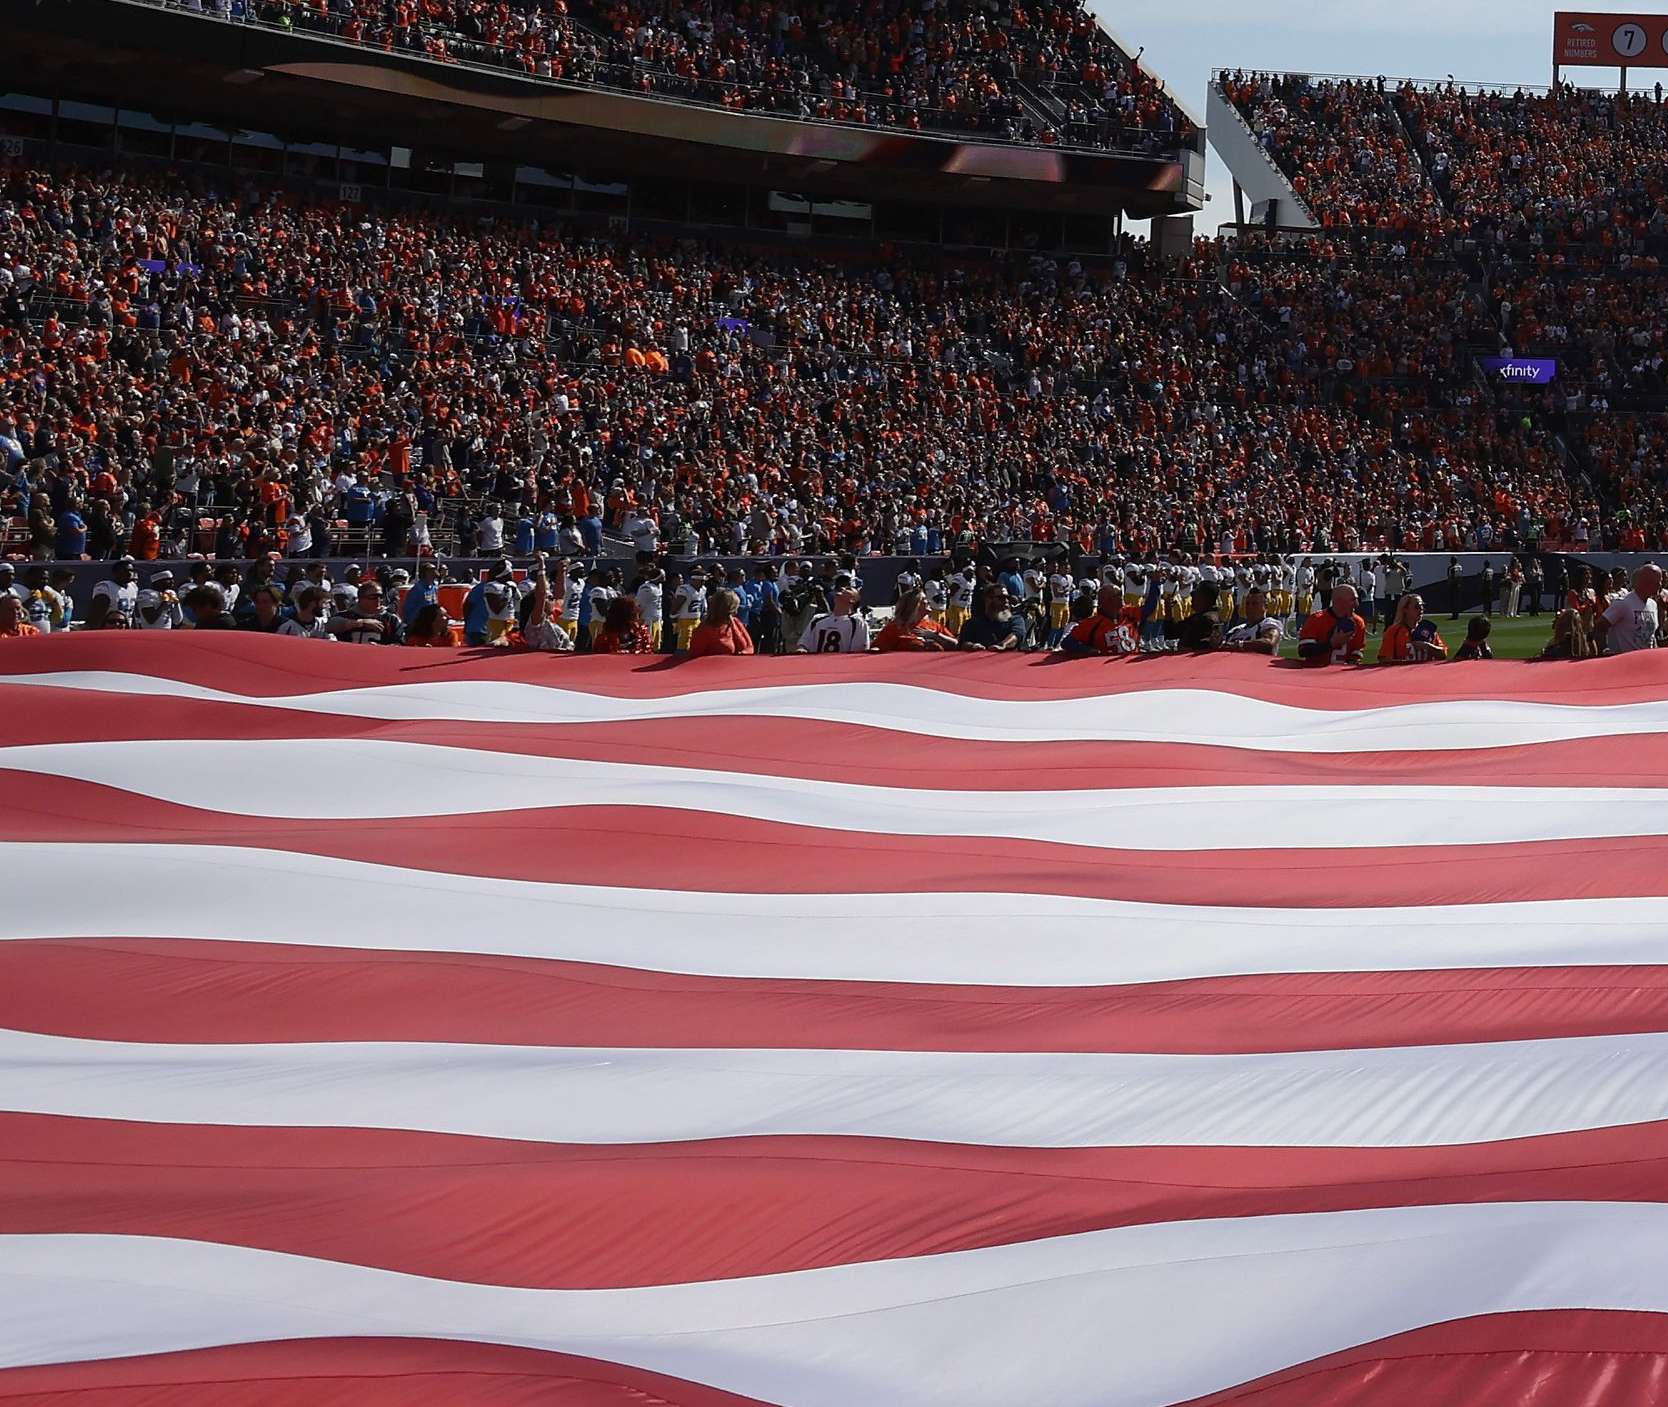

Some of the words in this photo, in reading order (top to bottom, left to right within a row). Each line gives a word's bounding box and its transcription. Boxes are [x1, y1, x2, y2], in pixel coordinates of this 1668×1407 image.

[1567, 37, 1596, 49] RETIRED
[1624, 30, 1635, 51] 7
[1564, 48, 1598, 59] NUMBERS
[1500, 363, 1540, 379] xfinity
[816, 628, 842, 653] 18
